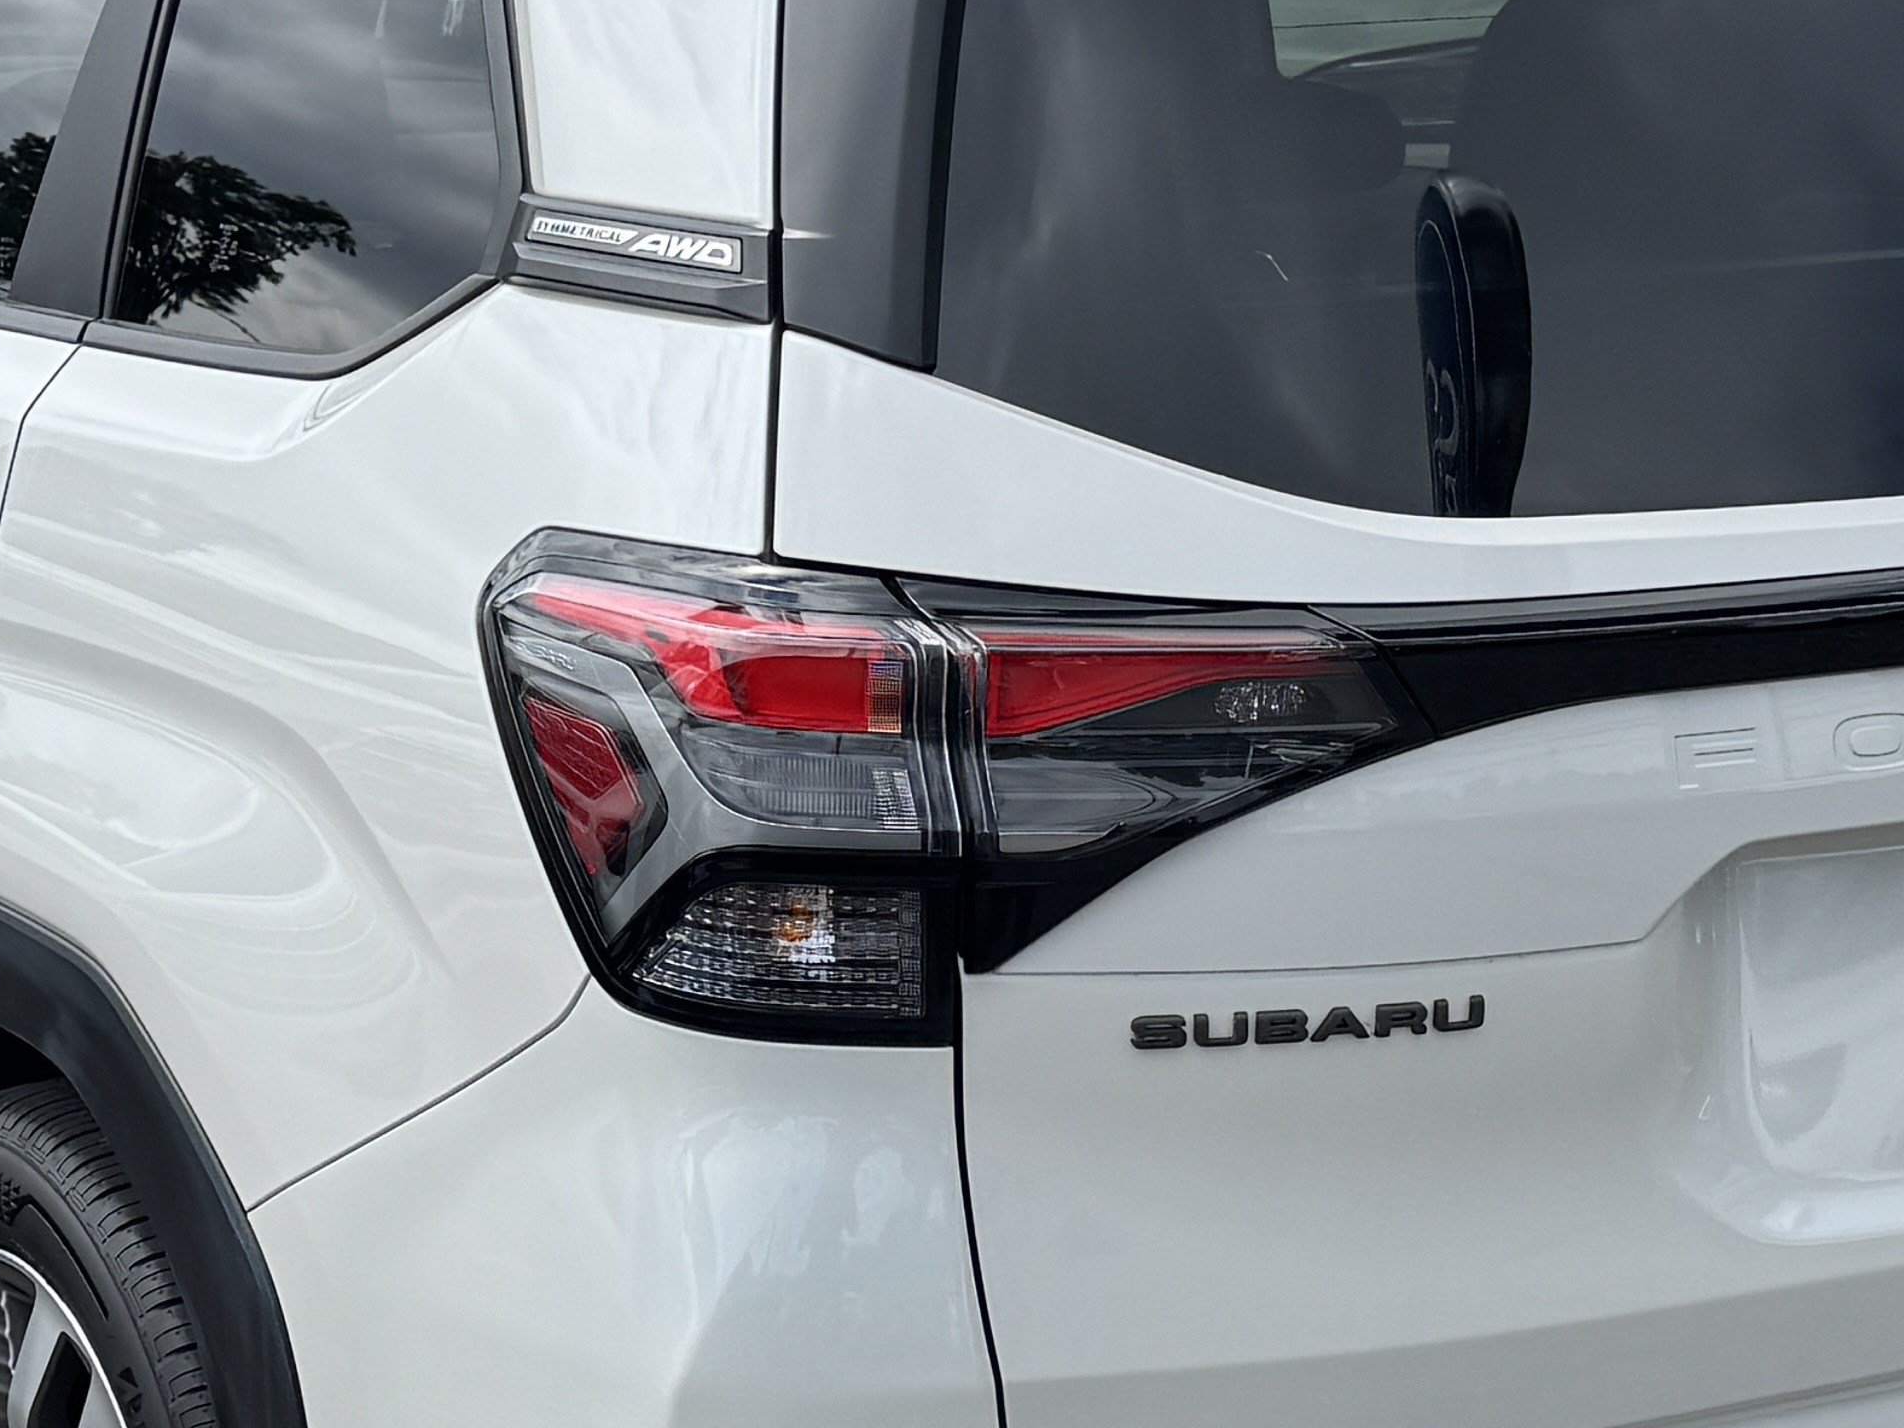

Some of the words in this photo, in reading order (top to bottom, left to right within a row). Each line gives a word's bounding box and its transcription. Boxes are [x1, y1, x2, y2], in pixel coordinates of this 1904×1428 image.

[536, 219, 623, 243] SYMMETRICAL
[628, 232, 734, 267] AWD
[1130, 994, 1486, 1050] SUBARU
